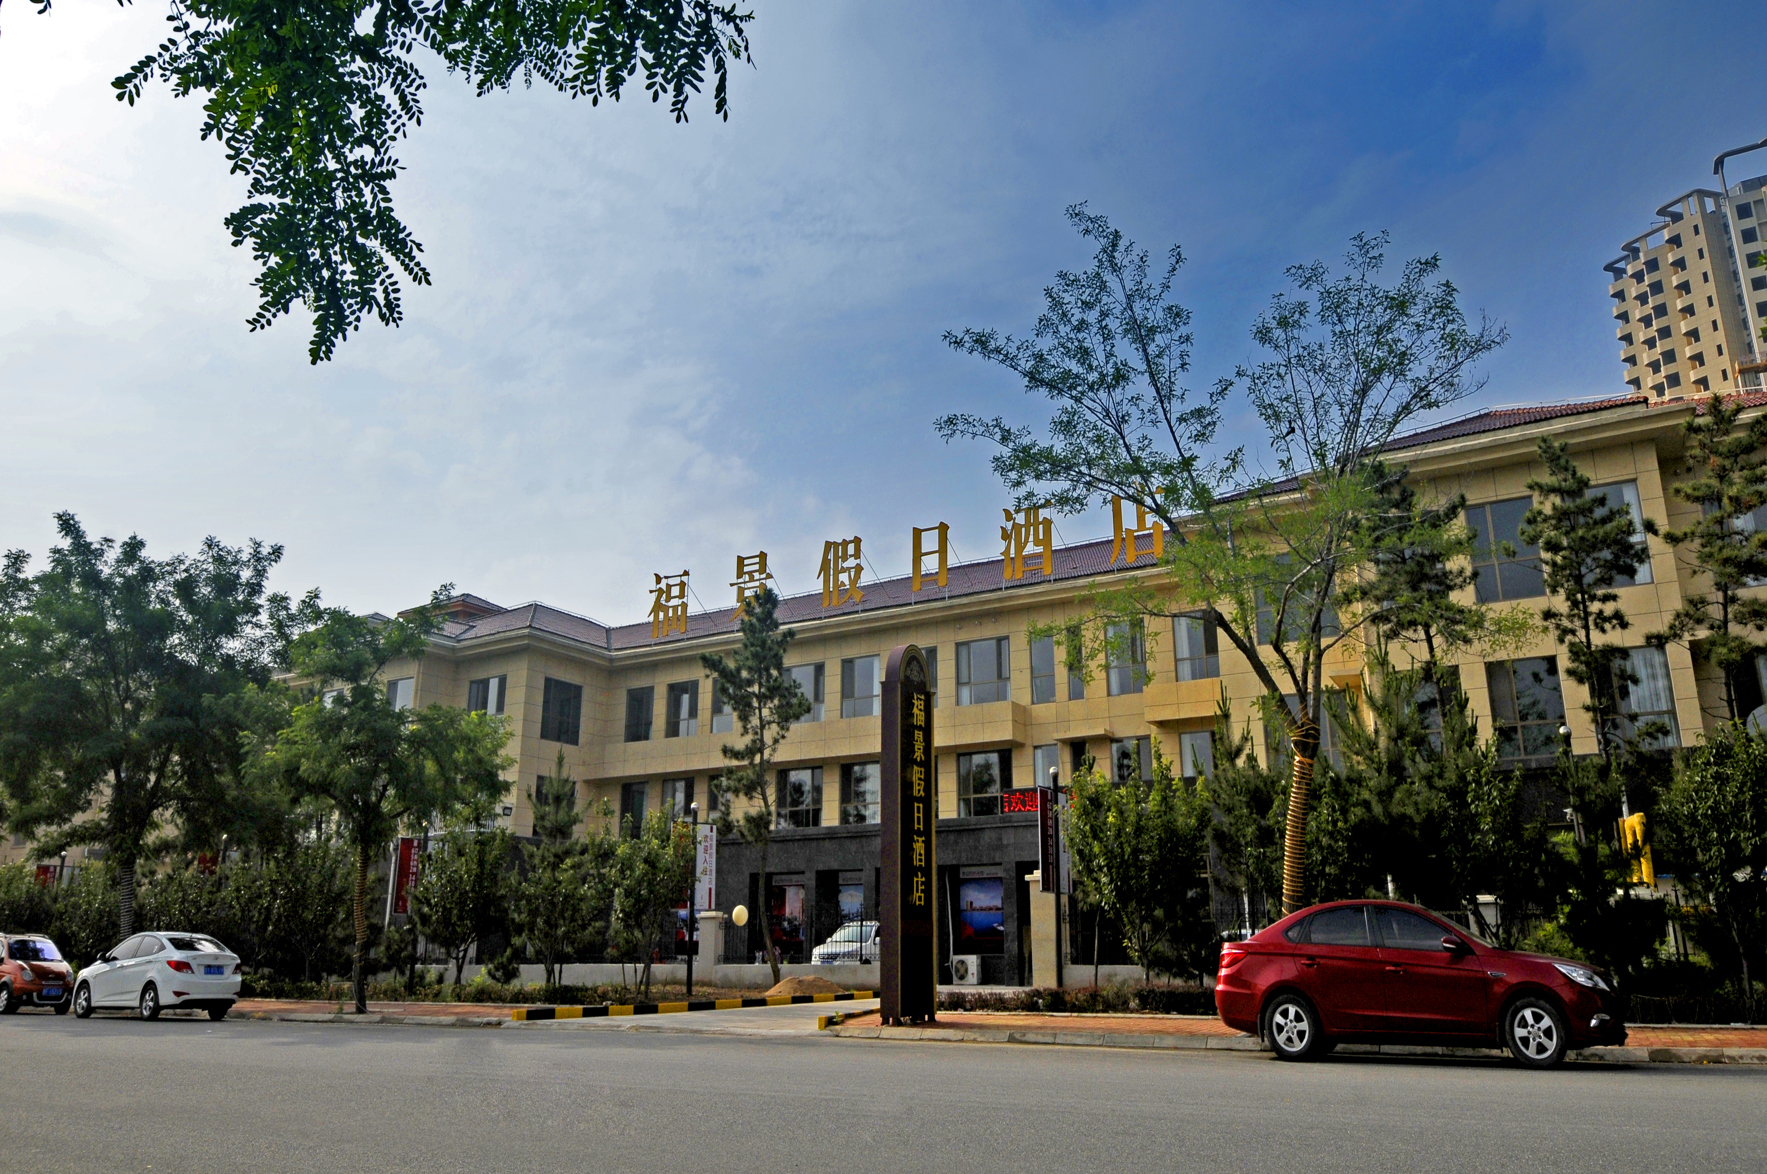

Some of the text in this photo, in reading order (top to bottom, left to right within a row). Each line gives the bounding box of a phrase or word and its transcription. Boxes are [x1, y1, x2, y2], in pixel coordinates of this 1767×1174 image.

[649, 481, 1165, 638] 福景假日酒店
[913, 692, 926, 906] 福景假日酒店
